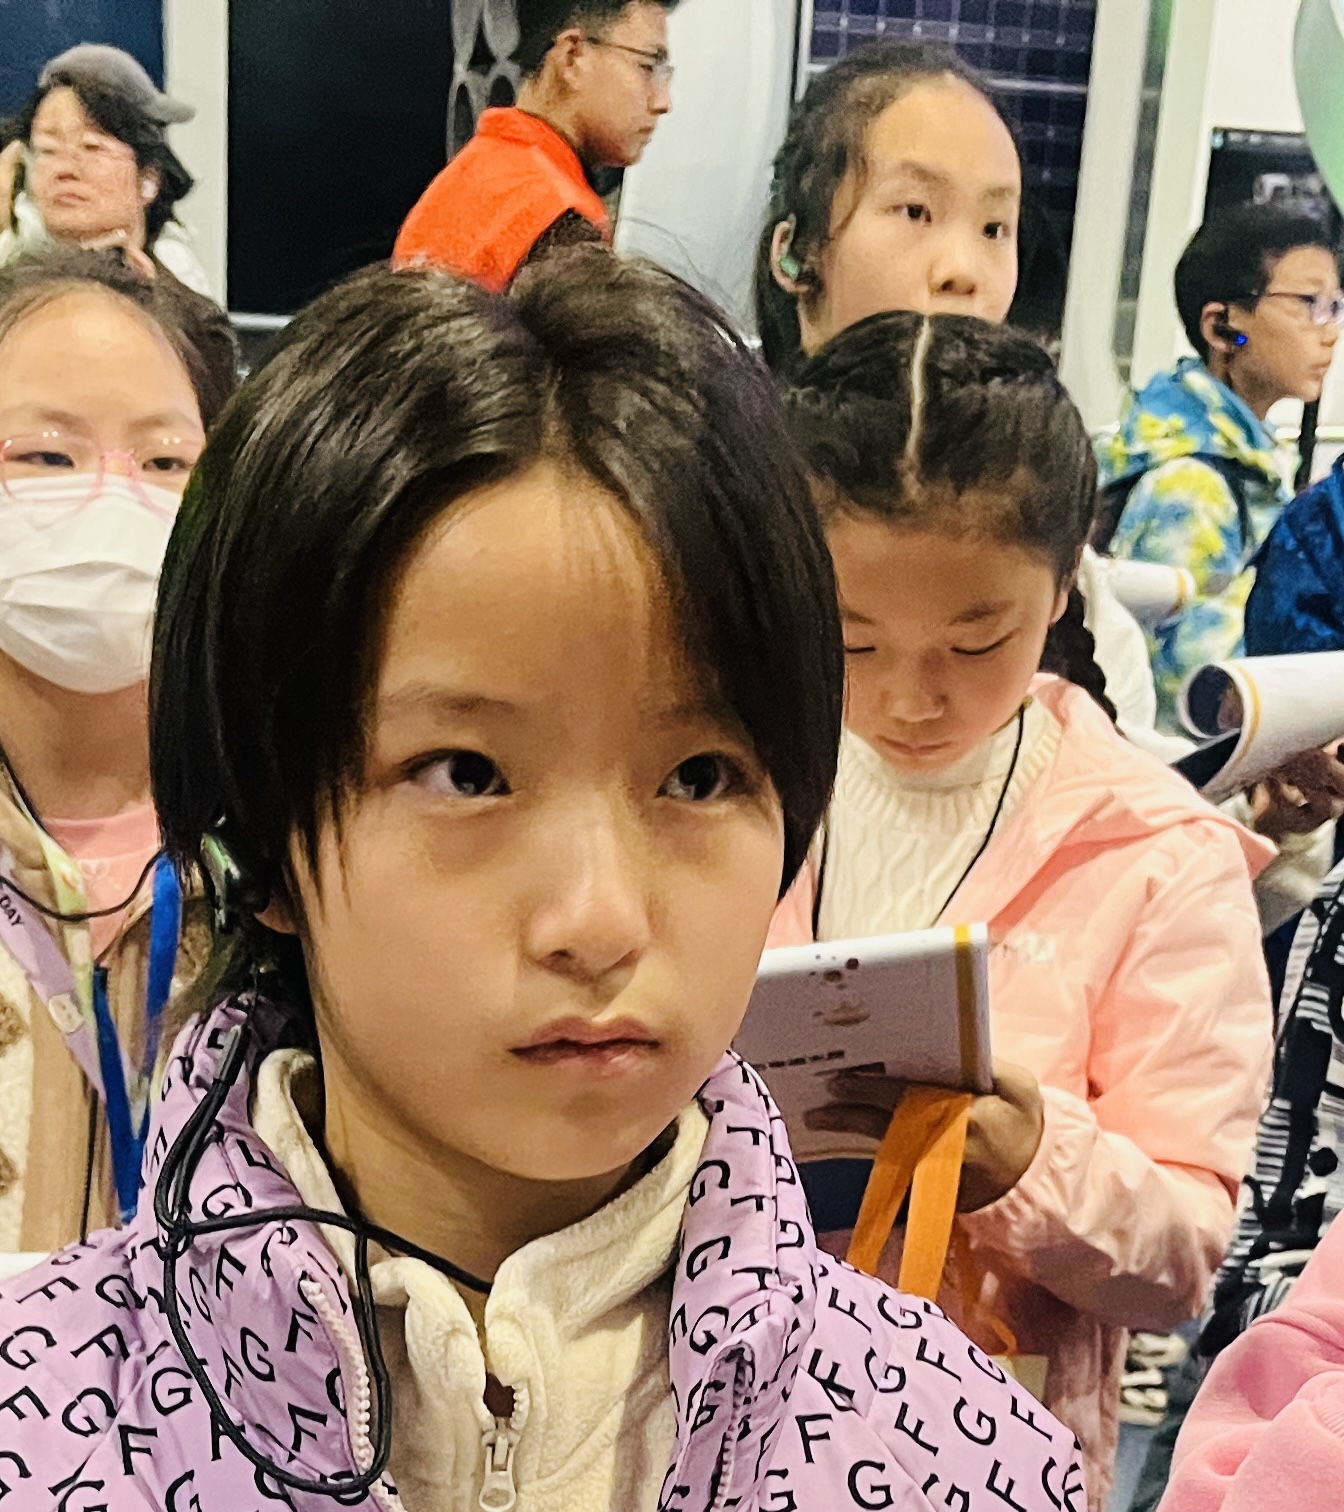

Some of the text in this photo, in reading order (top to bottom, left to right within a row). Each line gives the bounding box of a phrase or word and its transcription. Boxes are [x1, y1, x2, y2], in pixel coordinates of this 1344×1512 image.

[828, 1287, 871, 1333] F
[916, 1337, 961, 1382] F
[795, 1413, 832, 1463] F
[894, 1402, 939, 1456] F
[953, 1397, 996, 1446] G
[1010, 1395, 1052, 1442] F
[118, 1424, 158, 1475] F
[848, 1460, 894, 1511] G
